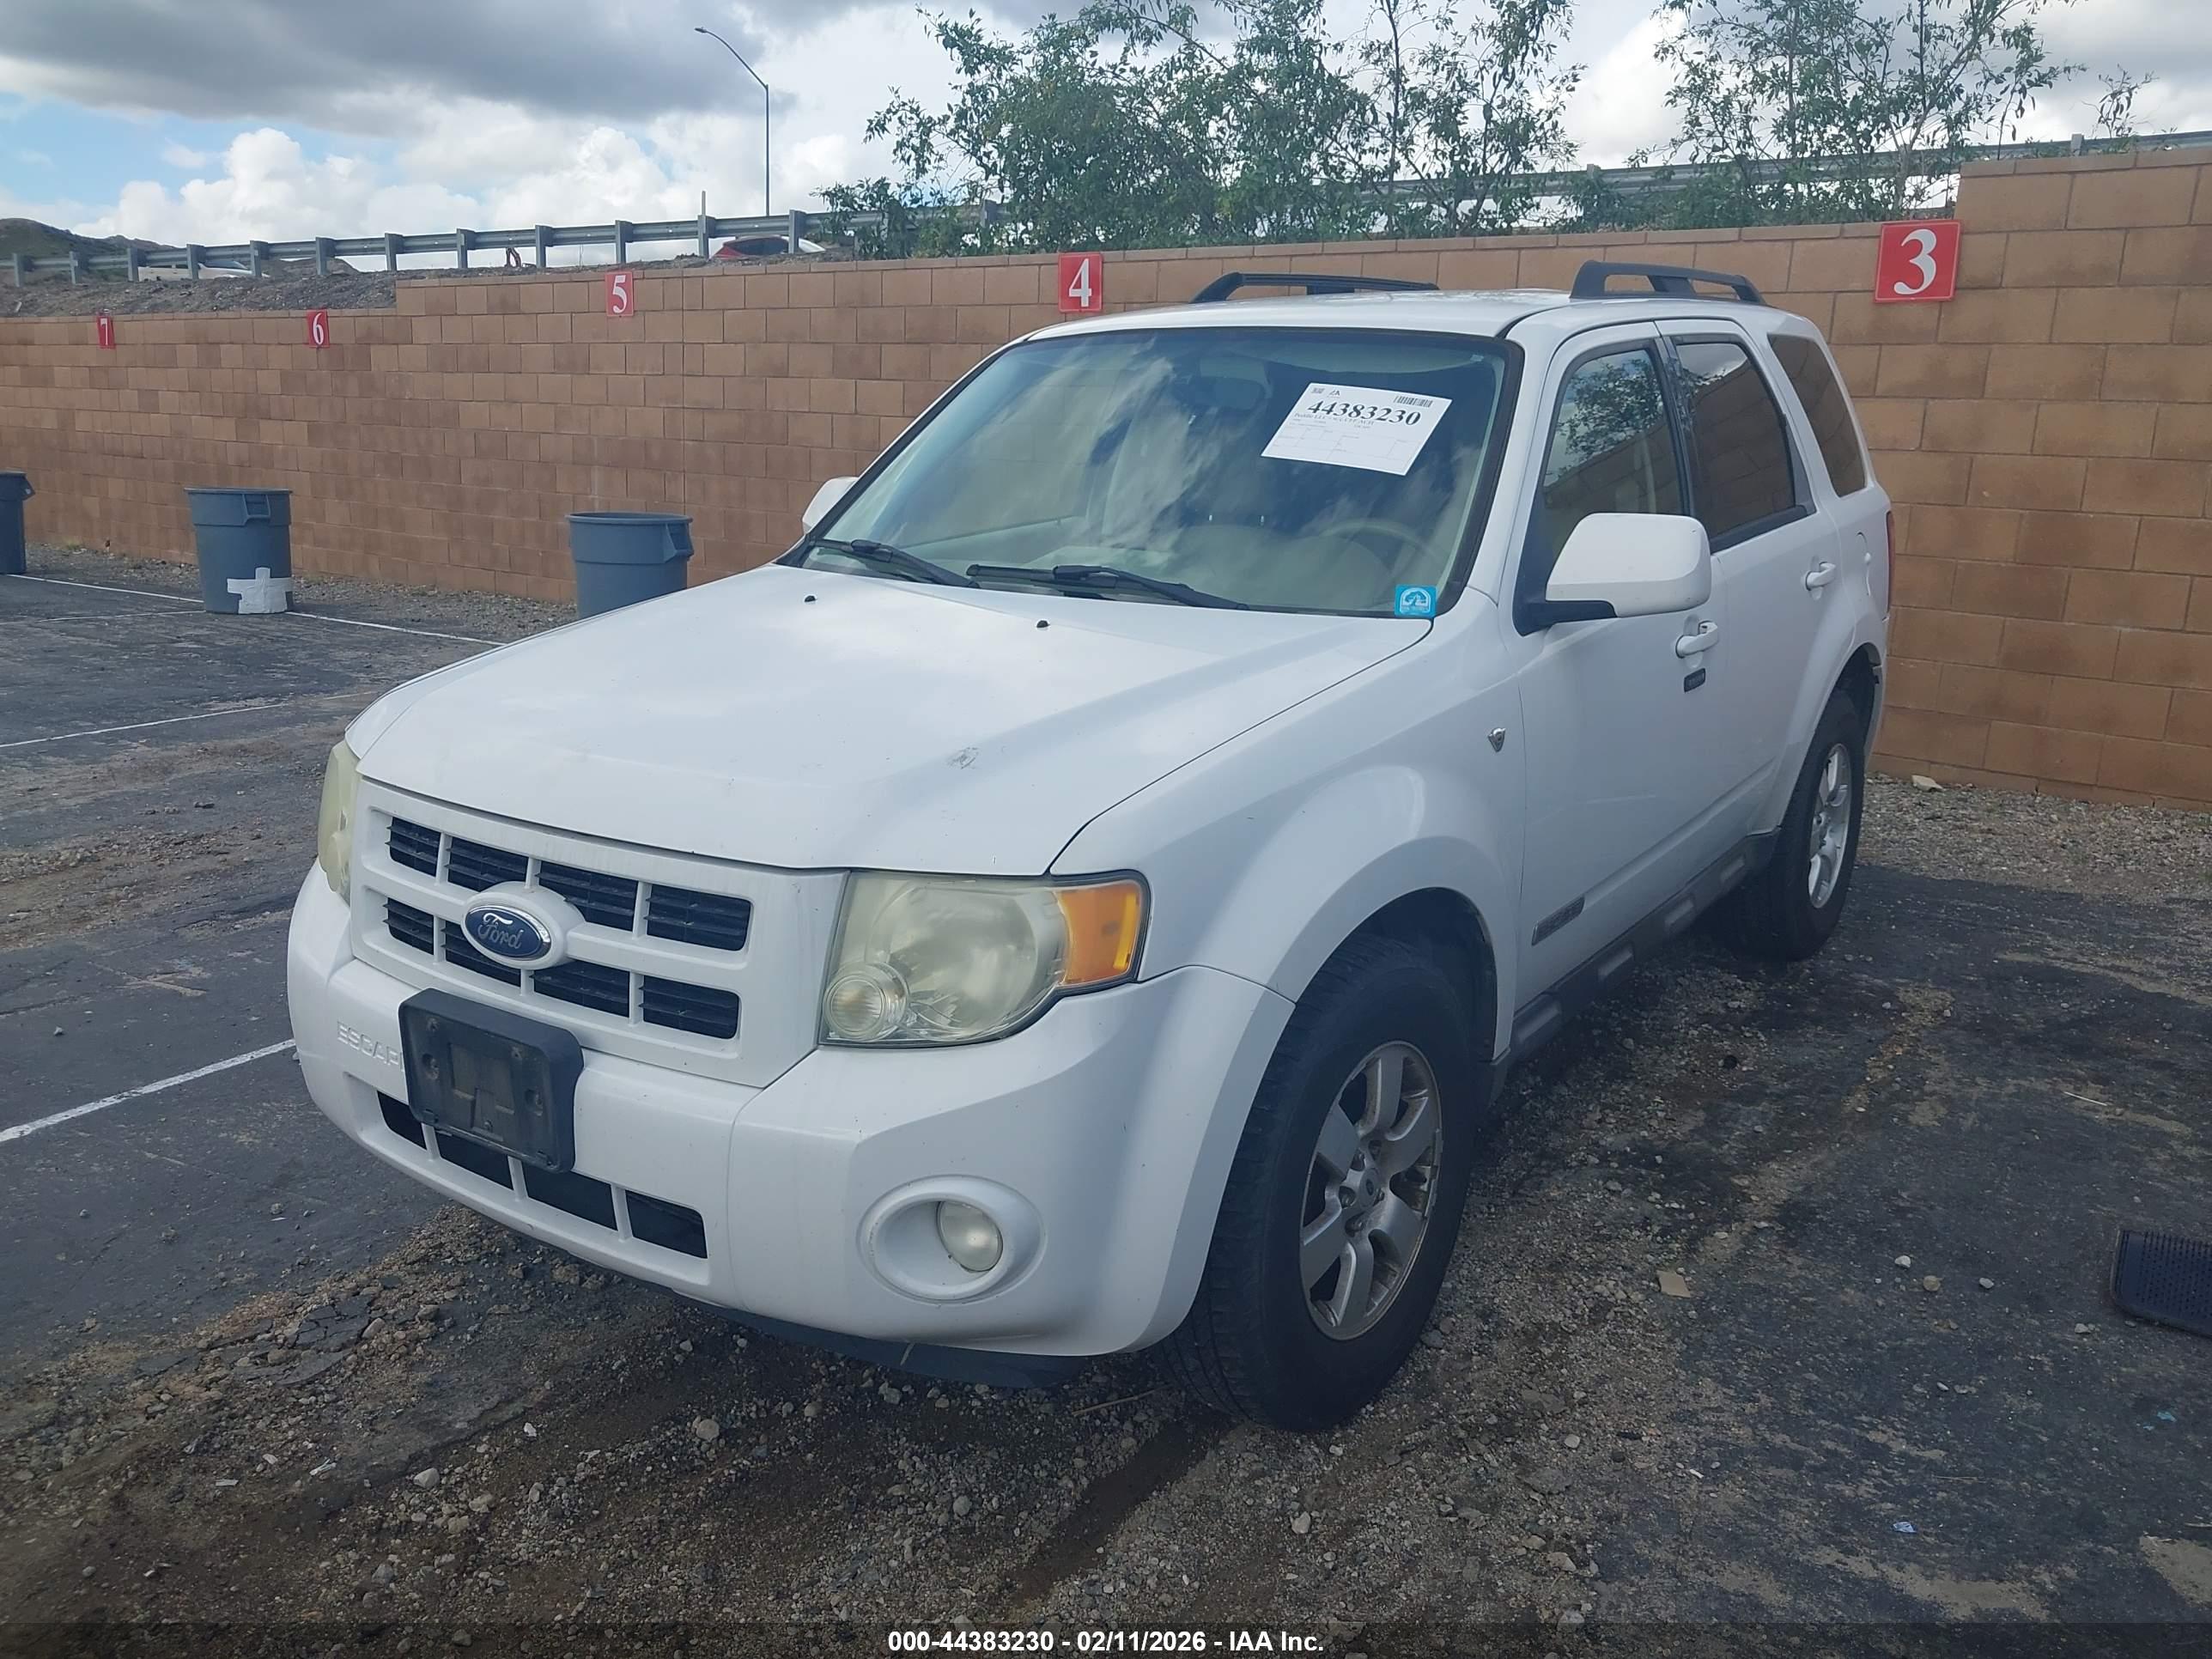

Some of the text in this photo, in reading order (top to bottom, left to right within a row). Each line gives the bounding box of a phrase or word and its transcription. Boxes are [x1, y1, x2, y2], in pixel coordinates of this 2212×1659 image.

[1893, 228, 1937, 295] 3
[612, 274, 628, 314] 5
[1068, 258, 1093, 308] 4
[100, 317, 109, 346] 7
[313, 312, 325, 345] 6
[1307, 400, 1422, 426] 44383230
[477, 912, 525, 949] Ford
[337, 1020, 405, 1073] ESCAP
